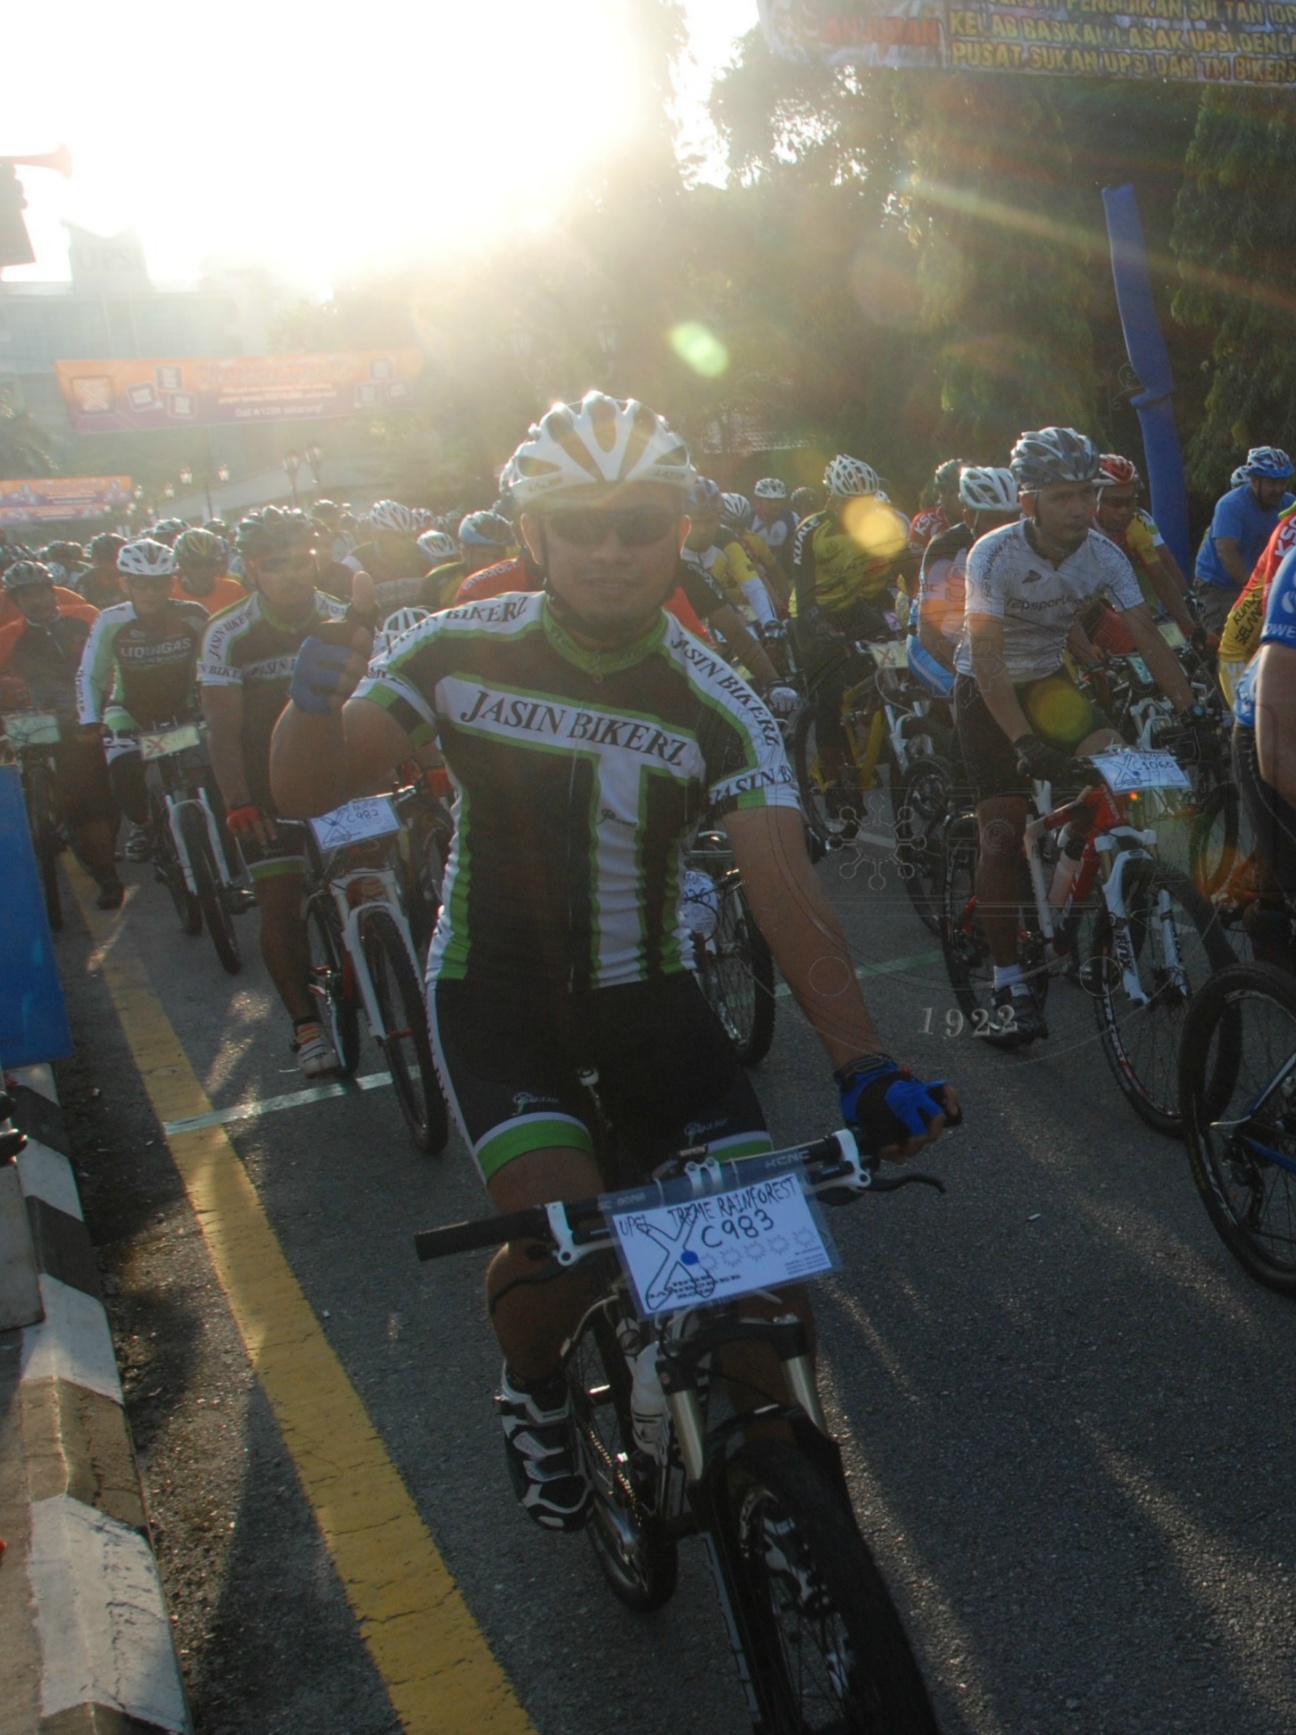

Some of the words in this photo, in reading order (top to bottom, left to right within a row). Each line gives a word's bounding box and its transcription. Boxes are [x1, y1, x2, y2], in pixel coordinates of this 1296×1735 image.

[950, 11, 1019, 39] KELAB
[1022, 17, 1108, 45] BASIKAL
[1115, 23, 1184, 50] LASAK
[1189, 29, 1234, 53] UPSI
[1188, 1, 1264, 24] SULTAN
[951, 41, 1022, 67] PUSAT
[1028, 45, 1098, 72] SUKAN
[1102, 51, 1150, 75] UPSI
[1153, 53, 1197, 77] DAN
[1200, 56, 1231, 80] TM
[120, 638, 192, 659] LIQUIGAS
[671, 631, 725, 678] JASIN
[460, 690, 566, 738] JASIN
[569, 710, 689, 767] BIKERZ
[718, 1175, 798, 1219] RAINFOREST
[701, 1208, 774, 1249] C983
